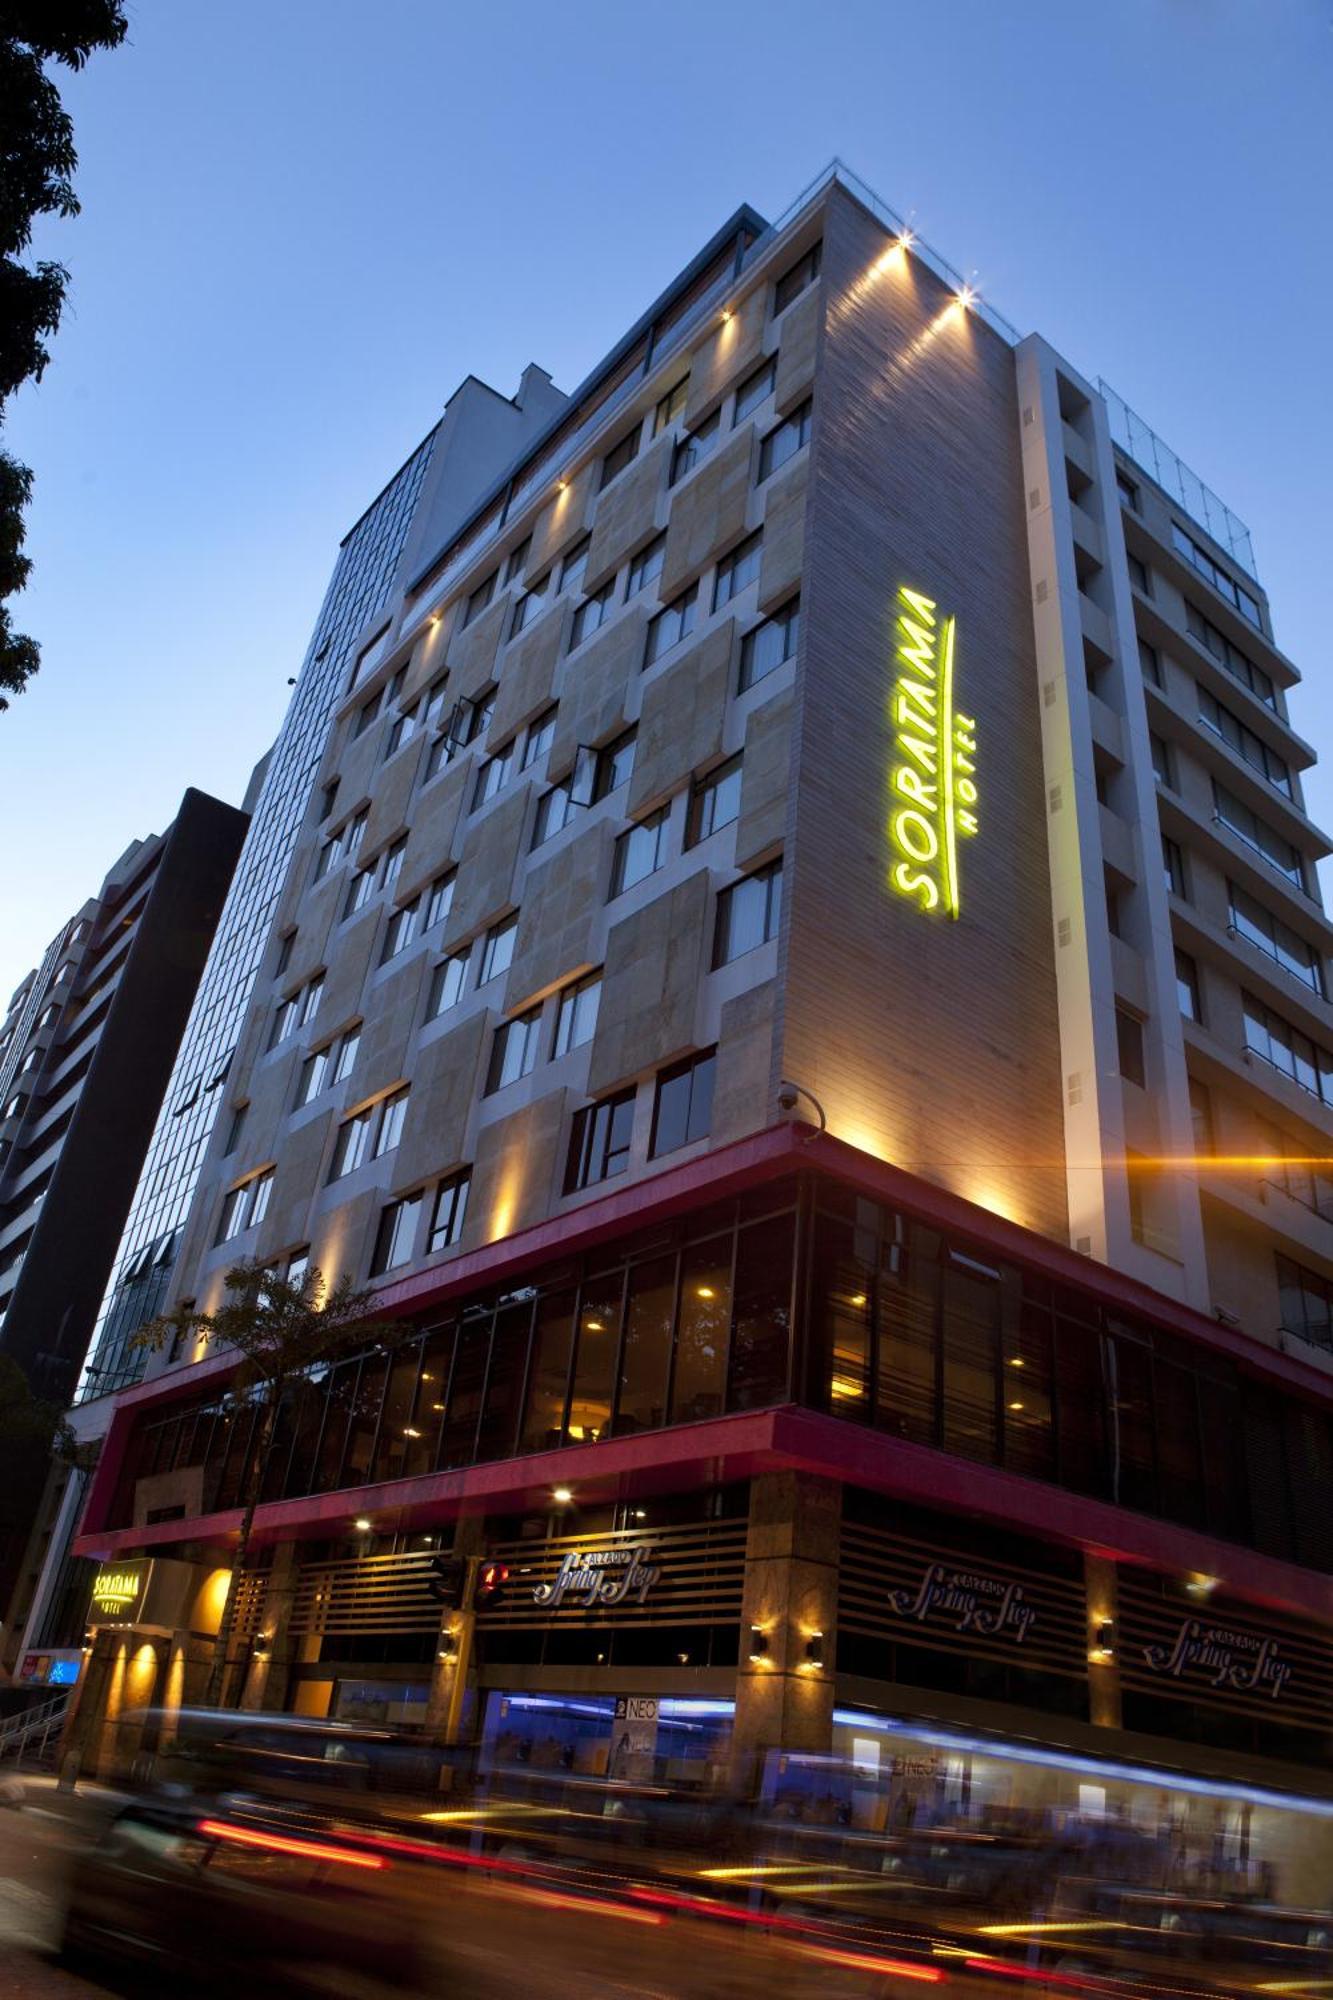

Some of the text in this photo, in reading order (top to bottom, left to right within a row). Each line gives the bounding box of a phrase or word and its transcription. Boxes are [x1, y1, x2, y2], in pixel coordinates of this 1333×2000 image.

[896, 586, 938, 909] SORATAMA
[956, 713, 978, 834] HOTEL
[93, 1574, 139, 1596] SORATAMA
[533, 1546, 662, 1606] Spring Step
[887, 1563, 1036, 1642] Spring Step
[1142, 1618, 1292, 1698] Spring Step
